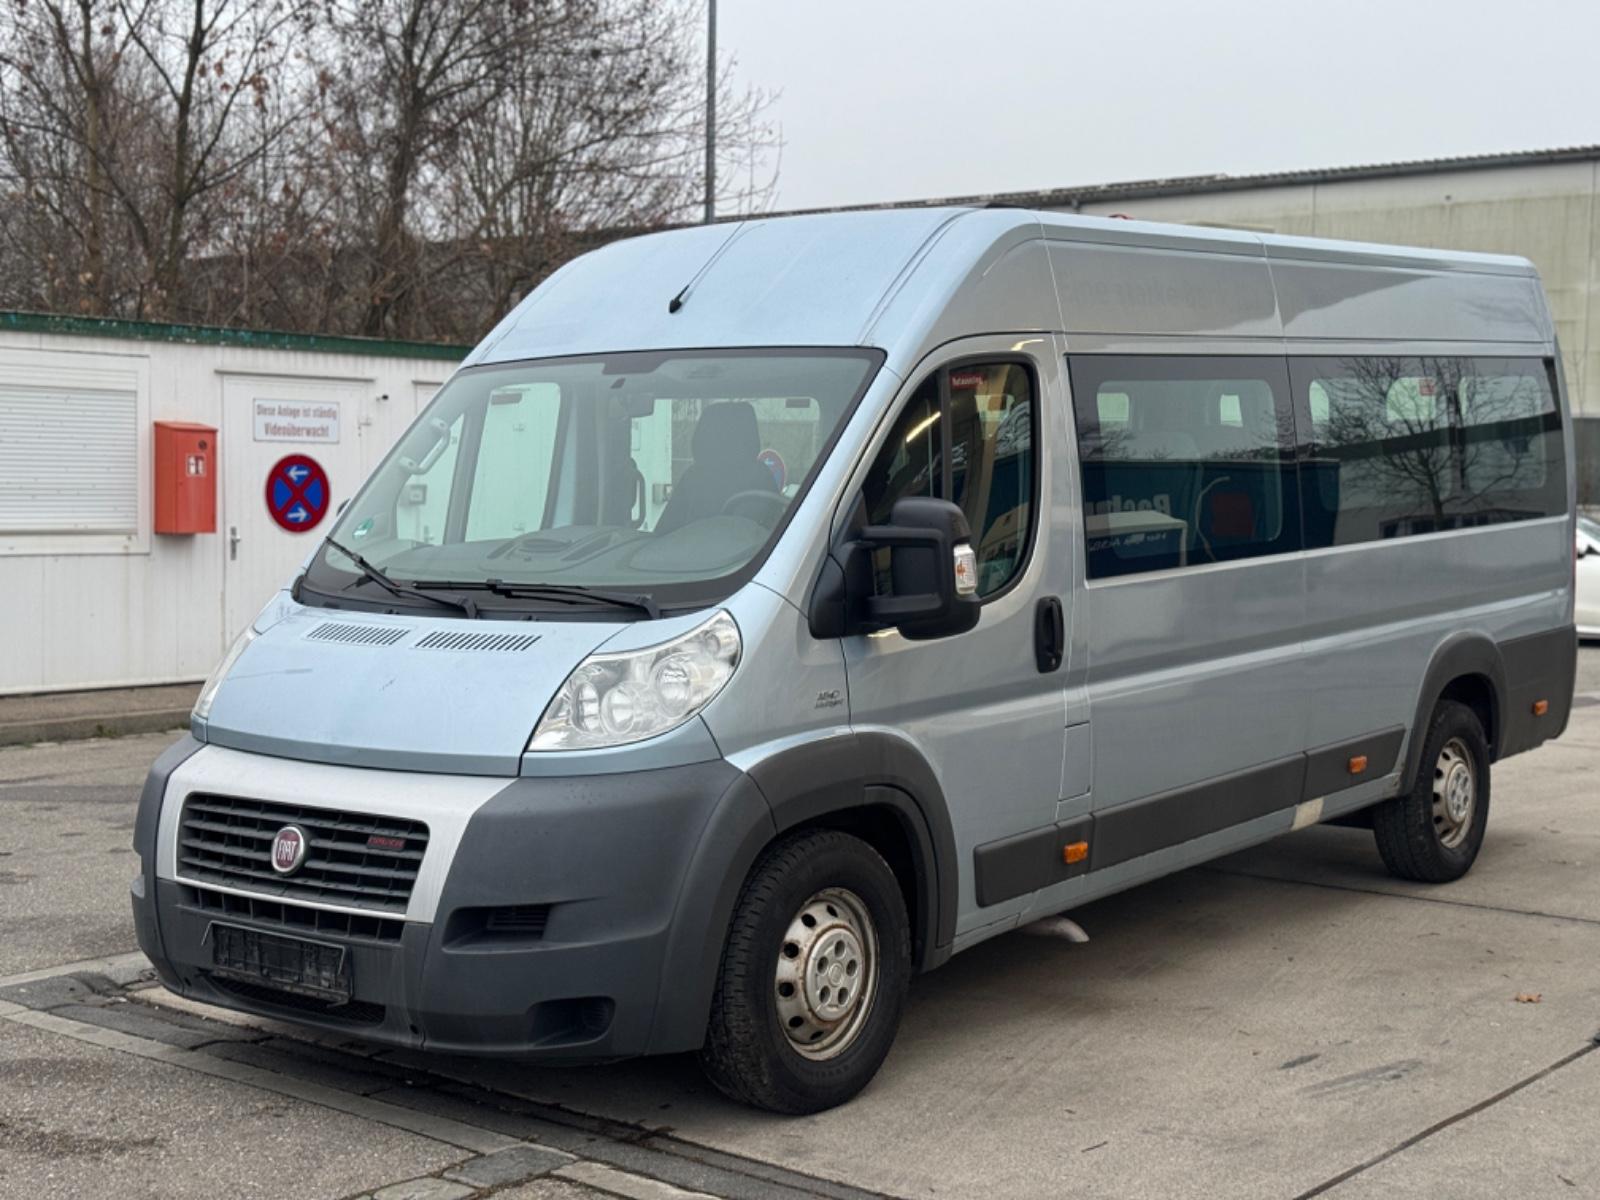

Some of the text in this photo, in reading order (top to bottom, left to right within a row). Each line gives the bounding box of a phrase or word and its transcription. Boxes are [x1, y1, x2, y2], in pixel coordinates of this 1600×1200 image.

[256, 404, 337, 421] Diese Anlage ist ständig
[277, 839, 298, 862] FIAT
